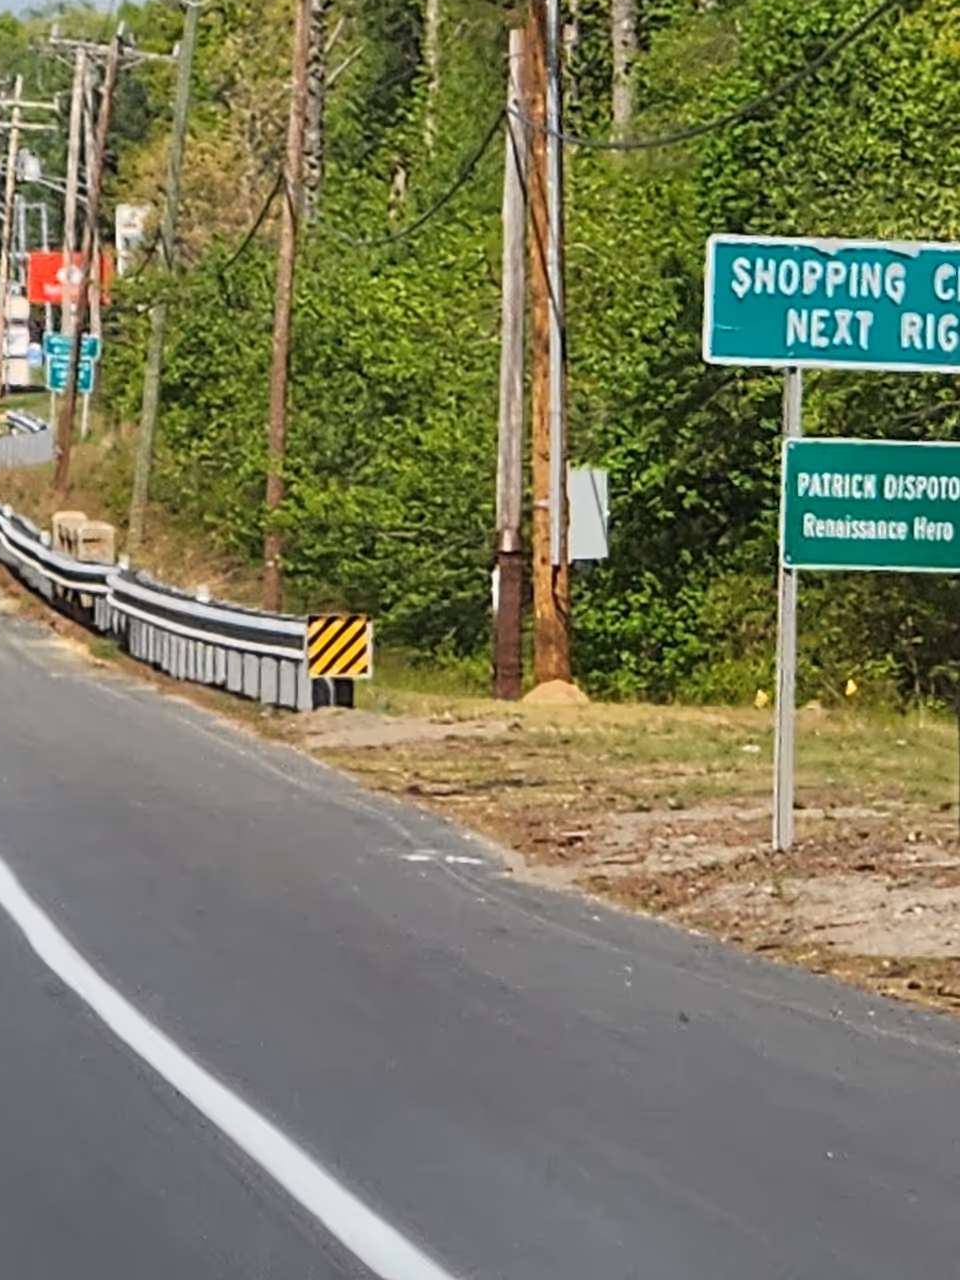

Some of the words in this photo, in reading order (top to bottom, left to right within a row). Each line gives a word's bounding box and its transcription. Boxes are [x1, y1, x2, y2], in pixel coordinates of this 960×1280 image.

[731, 257, 907, 304] SHOPPING
[933, 263, 960, 302] C
[786, 308, 874, 350] NEXT
[900, 312, 959, 352] RIG
[797, 472, 877, 499] PATRICK
[883, 474, 960, 501] DISPOTO
[803, 512, 909, 541] Renaissance
[913, 516, 955, 542] Hero
